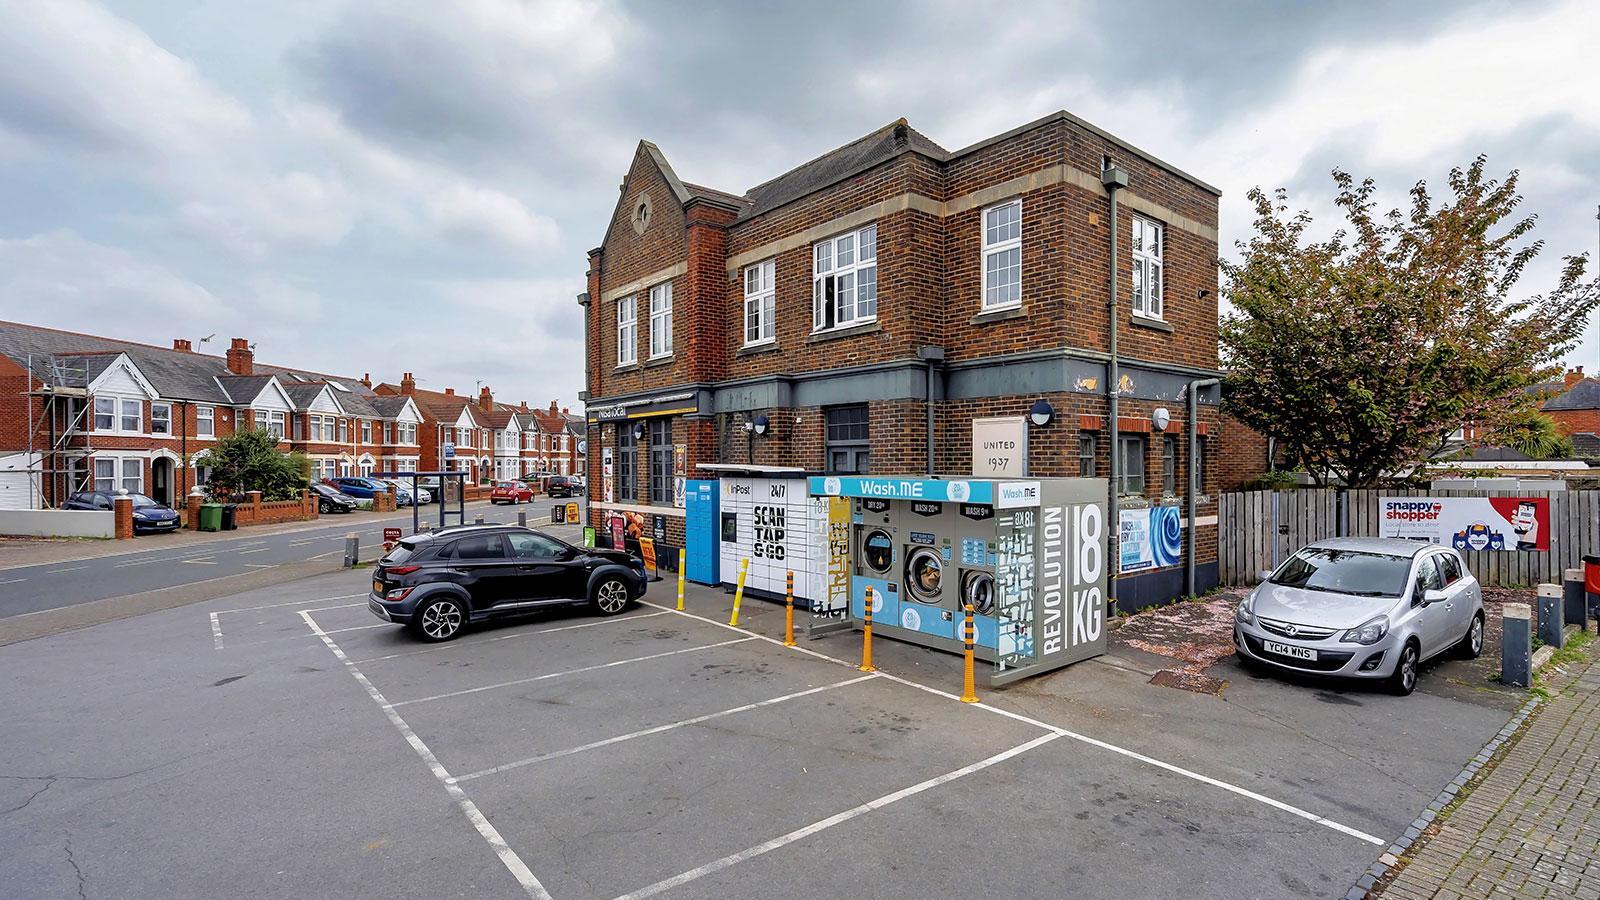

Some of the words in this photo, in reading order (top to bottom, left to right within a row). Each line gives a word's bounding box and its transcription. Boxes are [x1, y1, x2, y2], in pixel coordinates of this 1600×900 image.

[983, 441, 1015, 450] UNITED
[988, 458, 1009, 471] 1937
[731, 484, 750, 494] InPost
[771, 484, 785, 498] 24/7
[1003, 487, 1036, 498] Wash.ME
[1386, 502, 1433, 512] snappy
[754, 506, 785, 527] SCAN
[1386, 510, 1439, 522] shopper
[754, 527, 785, 544] TAP
[1073, 503, 1102, 586] 18
[1043, 507, 1061, 655] REVOLUTION
[1072, 587, 1101, 646] KG
[1269, 642, 1288, 654] YC14
[1291, 647, 1311, 658] WNS
